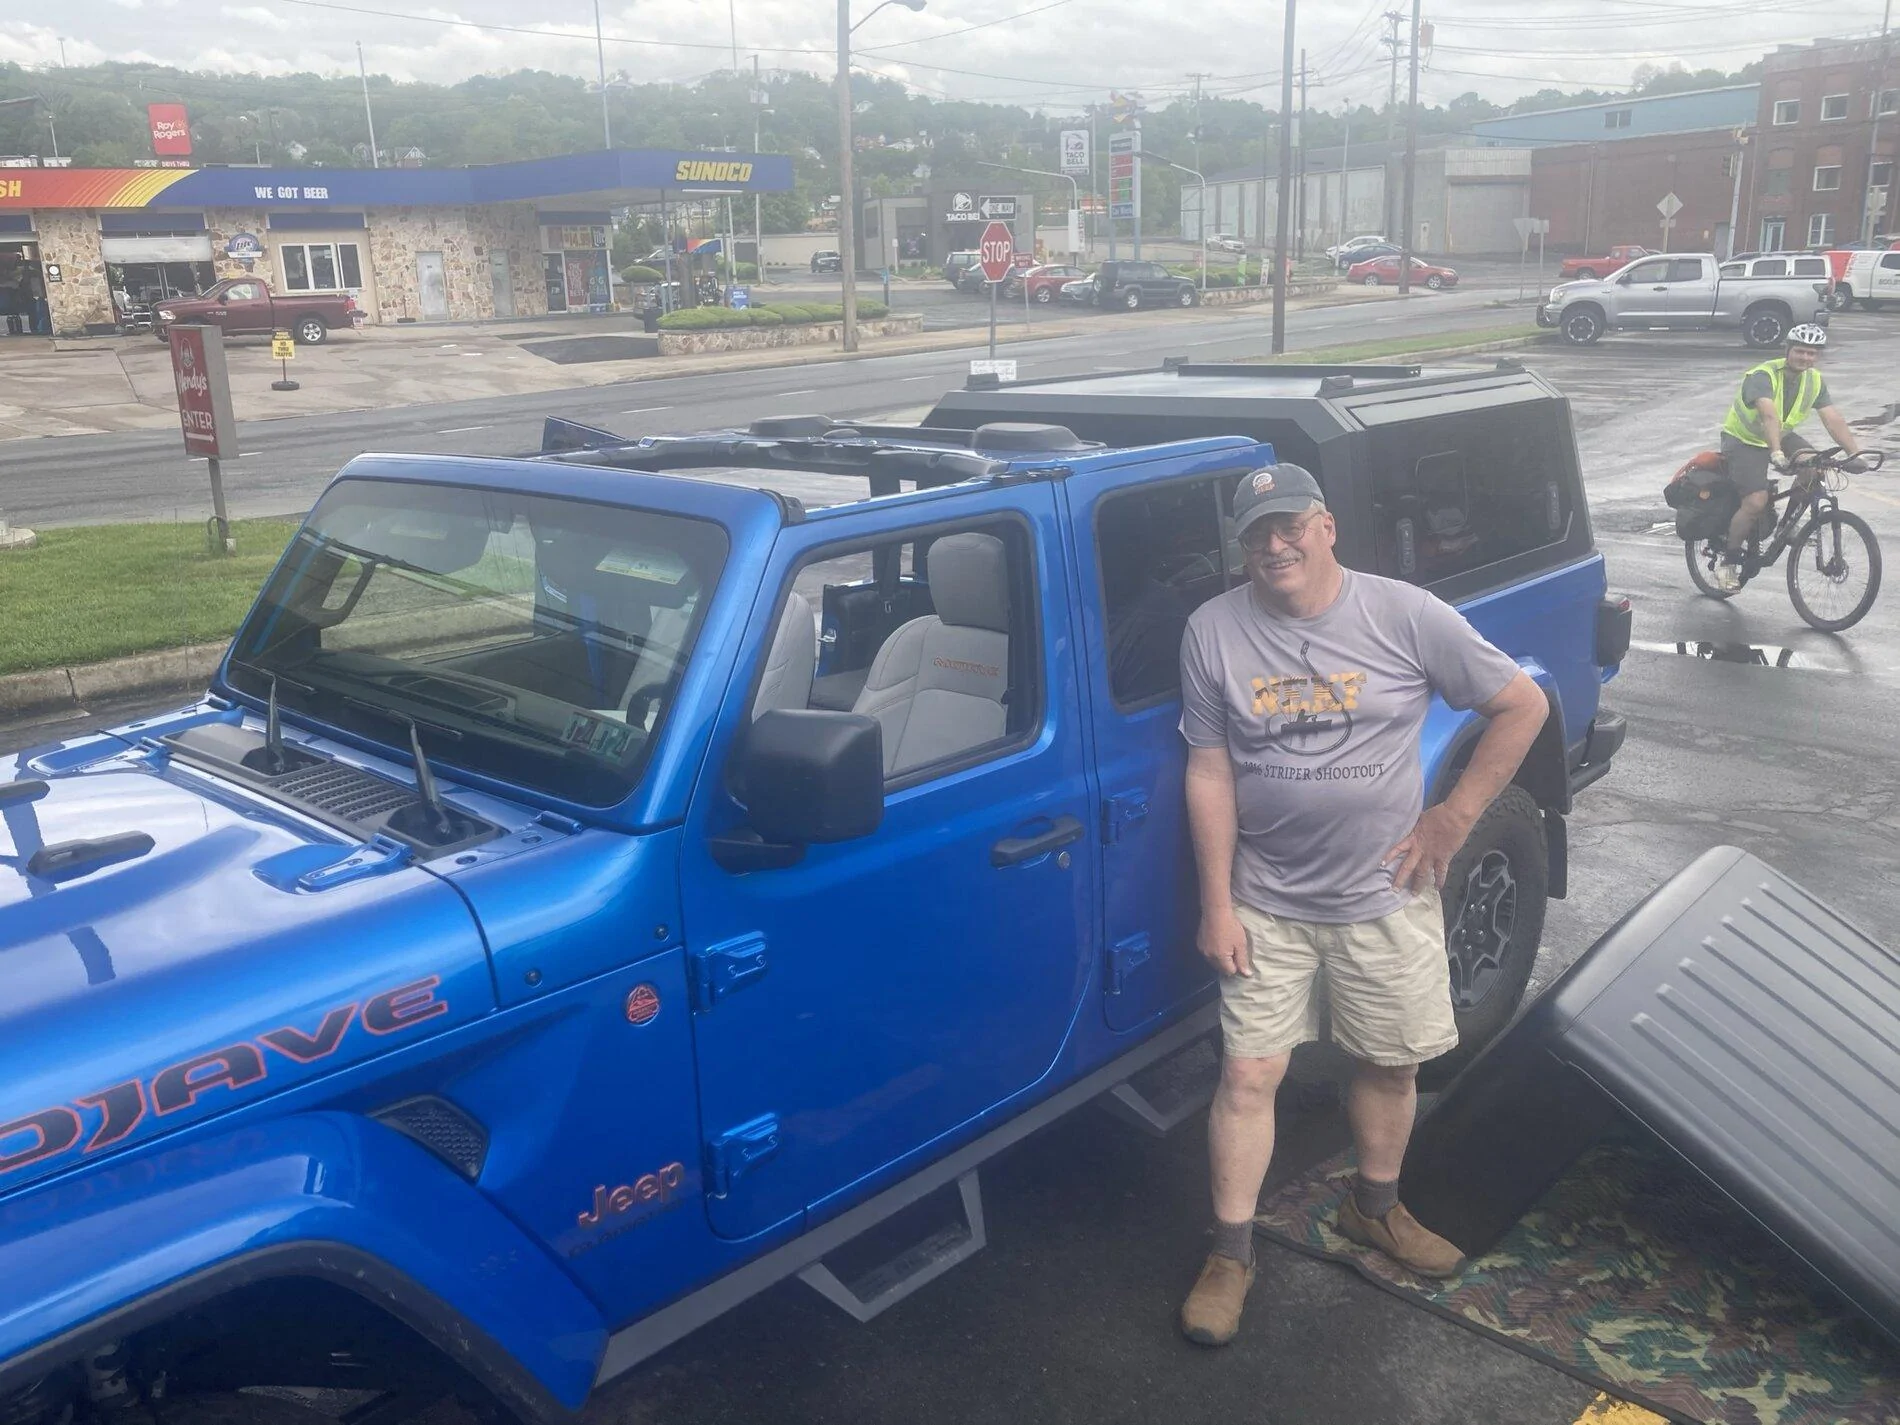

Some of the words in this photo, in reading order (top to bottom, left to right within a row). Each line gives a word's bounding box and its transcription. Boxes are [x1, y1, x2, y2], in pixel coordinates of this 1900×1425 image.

[153, 129, 186, 140] Rogers
[157, 121, 175, 131] Roy
[675, 160, 753, 182] SUNOCO
[254, 186, 274, 199] WE
[277, 186, 299, 199] GOT
[303, 187, 329, 199] BEER
[946, 213, 967, 221] TACO
[982, 240, 1011, 264] STOP
[176, 367, 208, 397] Wendy's
[181, 409, 214, 430] ENTER
[1263, 763, 1312, 782] STRIPER
[1315, 762, 1386, 782] SHOOTOUT
[578, 1161, 685, 1228] Jeep
